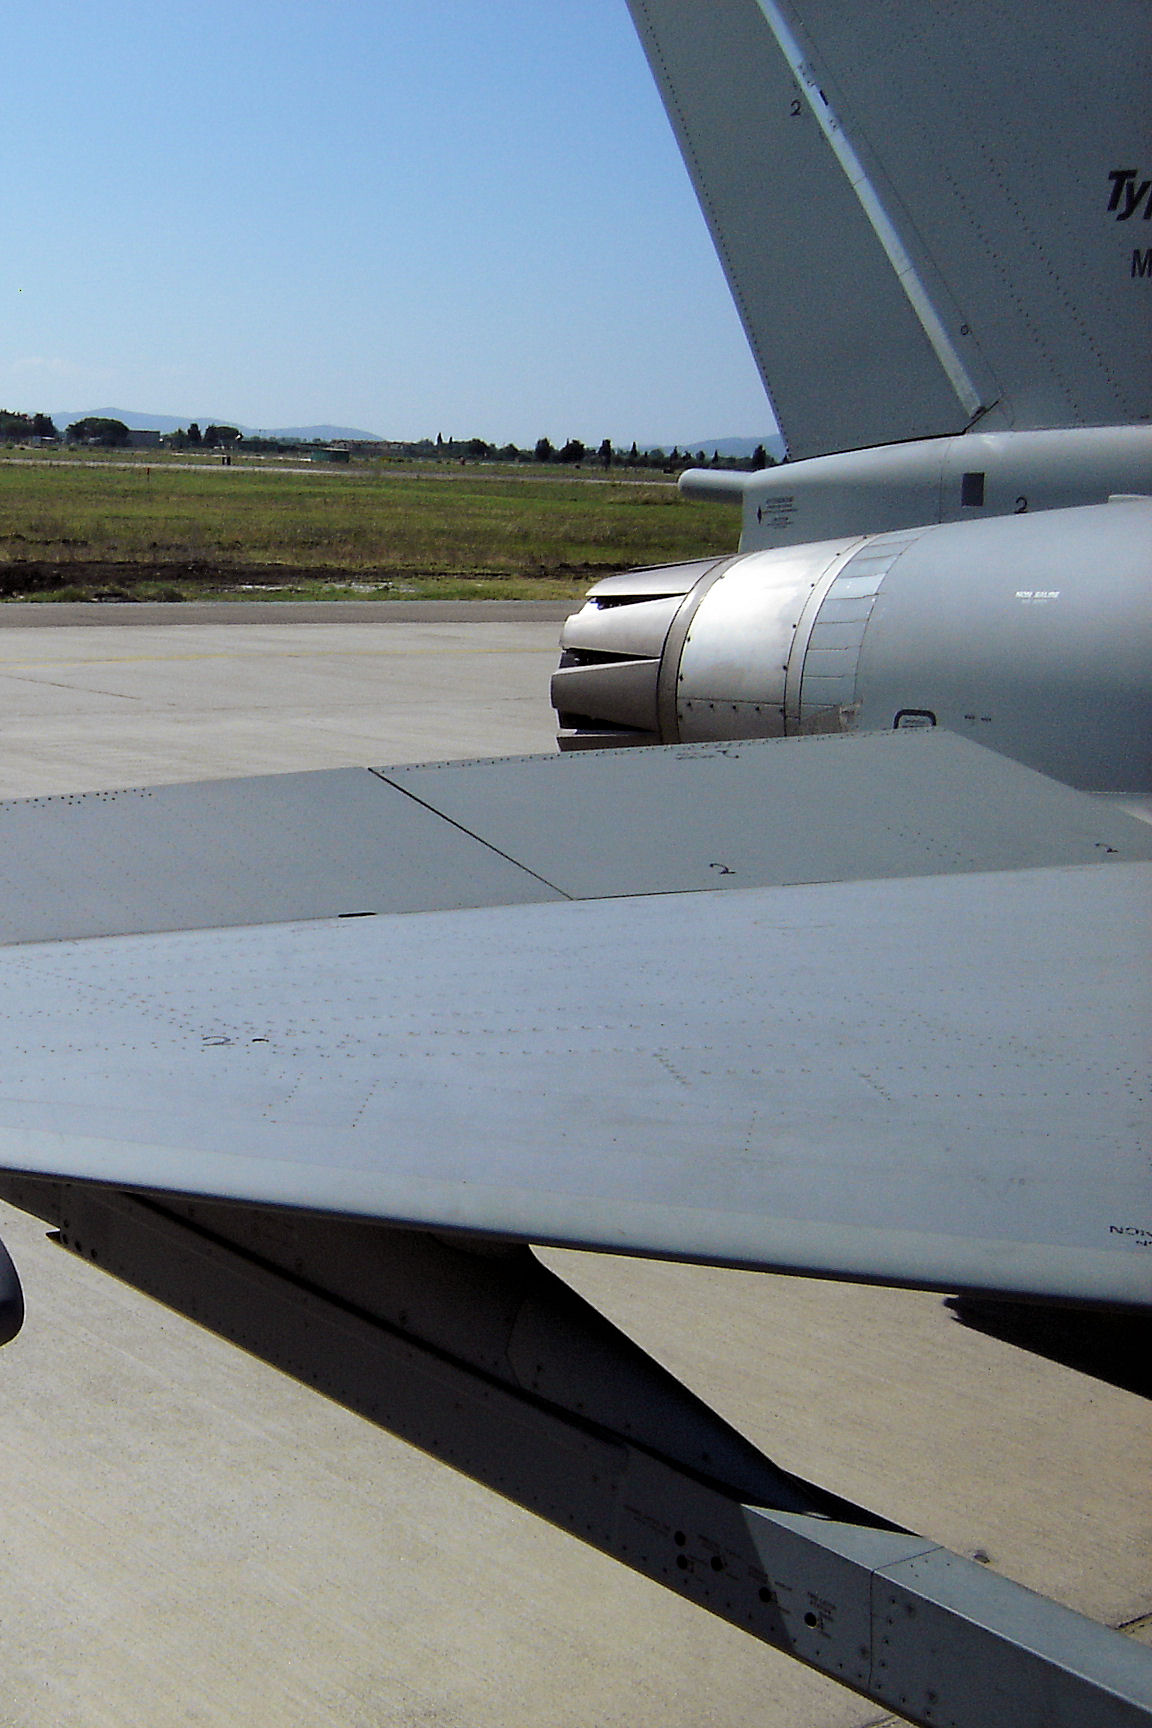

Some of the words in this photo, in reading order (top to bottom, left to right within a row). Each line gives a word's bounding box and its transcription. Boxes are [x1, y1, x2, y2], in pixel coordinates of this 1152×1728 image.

[790, 99, 801, 117] 2
[1014, 496, 1028, 514] 2
[709, 862, 736, 875] 2
